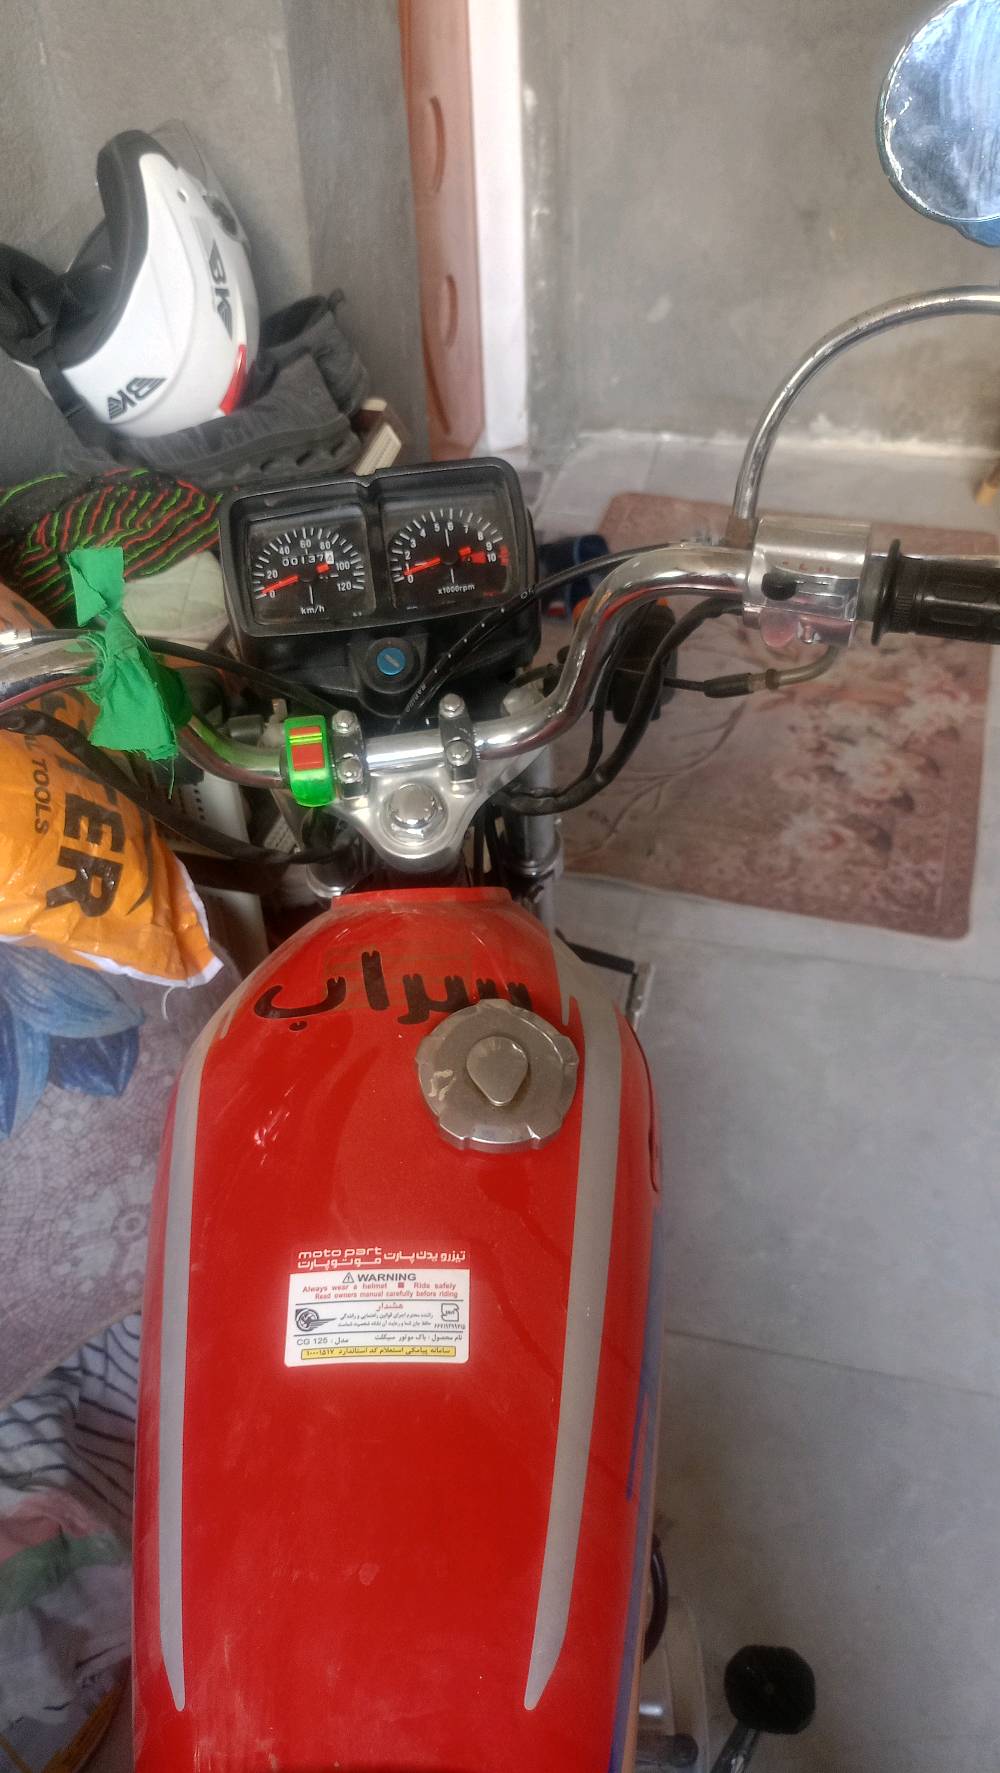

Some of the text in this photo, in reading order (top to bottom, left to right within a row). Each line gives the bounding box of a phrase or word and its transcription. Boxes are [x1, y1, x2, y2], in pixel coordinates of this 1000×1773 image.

[209, 239, 233, 342] BK
[434, 522, 440, 532] 5
[447, 522, 454, 531] 6
[463, 524, 469, 534] 7
[419, 528, 427, 538] 4
[477, 531, 484, 541] 8
[300, 539, 312, 549] 60
[319, 541, 331, 550] 80
[409, 539, 416, 548] 3
[485, 541, 493, 551] 9
[279, 546, 290, 555] 40
[404, 551, 411, 560] 2
[486, 553, 497, 562] 10
[336, 561, 351, 571] 100
[266, 570, 278, 580] 20
[407, 575, 414, 584] 0
[336, 581, 352, 592] 120
[300, 604, 325, 615] km/h
[33, 758, 51, 835] TOOLS
[298, 1246, 382, 1259] moto part
[357, 1273, 417, 1282] WARNING
[302, 1285, 328, 1293] Always
[434, 1282, 457, 1290] safely
[386, 1290, 413, 1298] carefully
[439, 1291, 459, 1299] riding
[313, 1337, 328, 1345] 125
